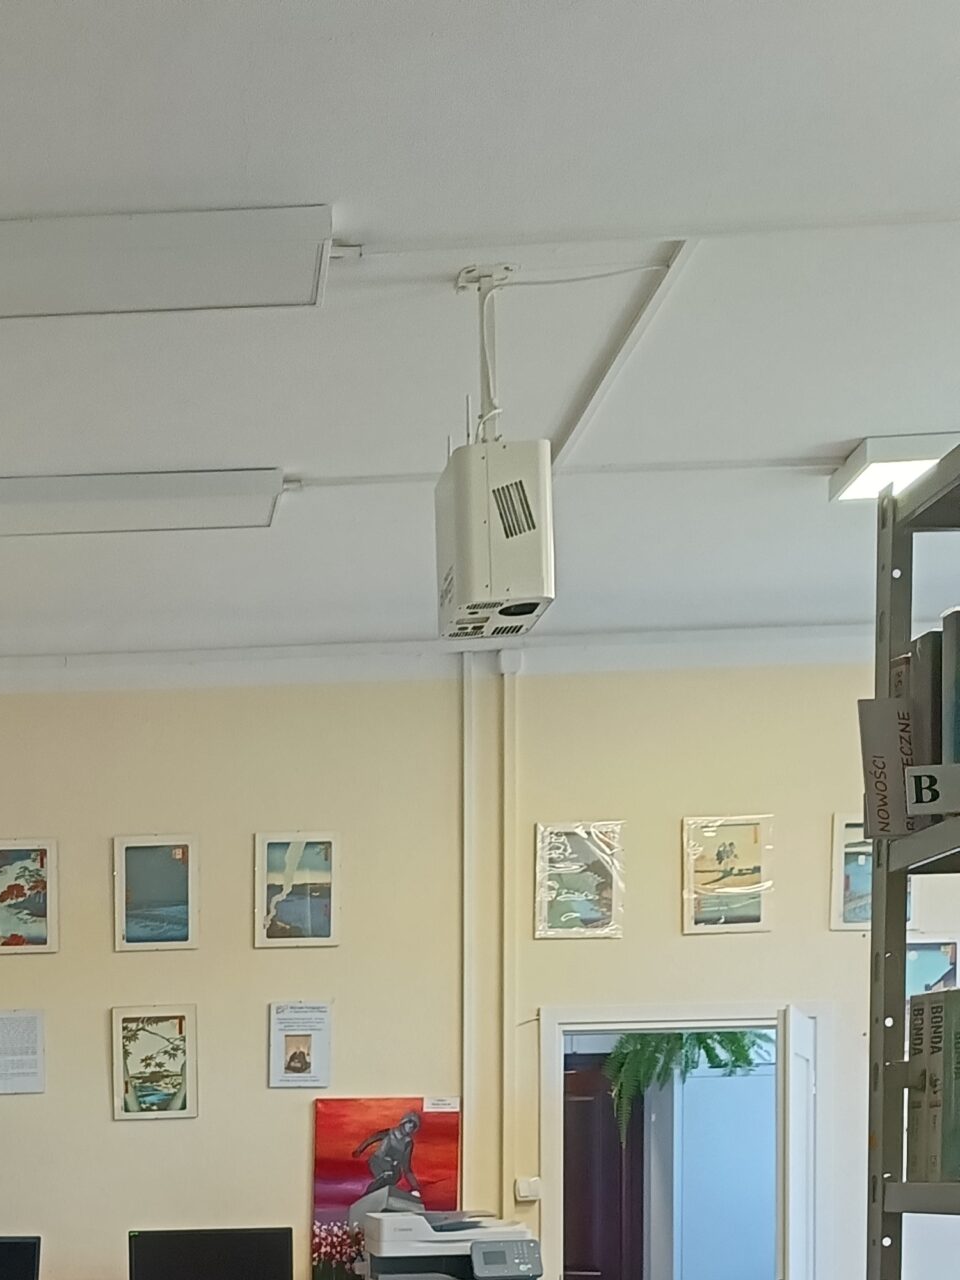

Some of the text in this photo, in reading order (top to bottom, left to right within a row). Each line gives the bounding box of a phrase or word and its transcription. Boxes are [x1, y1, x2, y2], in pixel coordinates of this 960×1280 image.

[868, 755, 891, 833] NOWOŚCI
[910, 774, 940, 805] B
[912, 1007, 925, 1057] BONDA
[930, 1005, 944, 1055] BONDA
